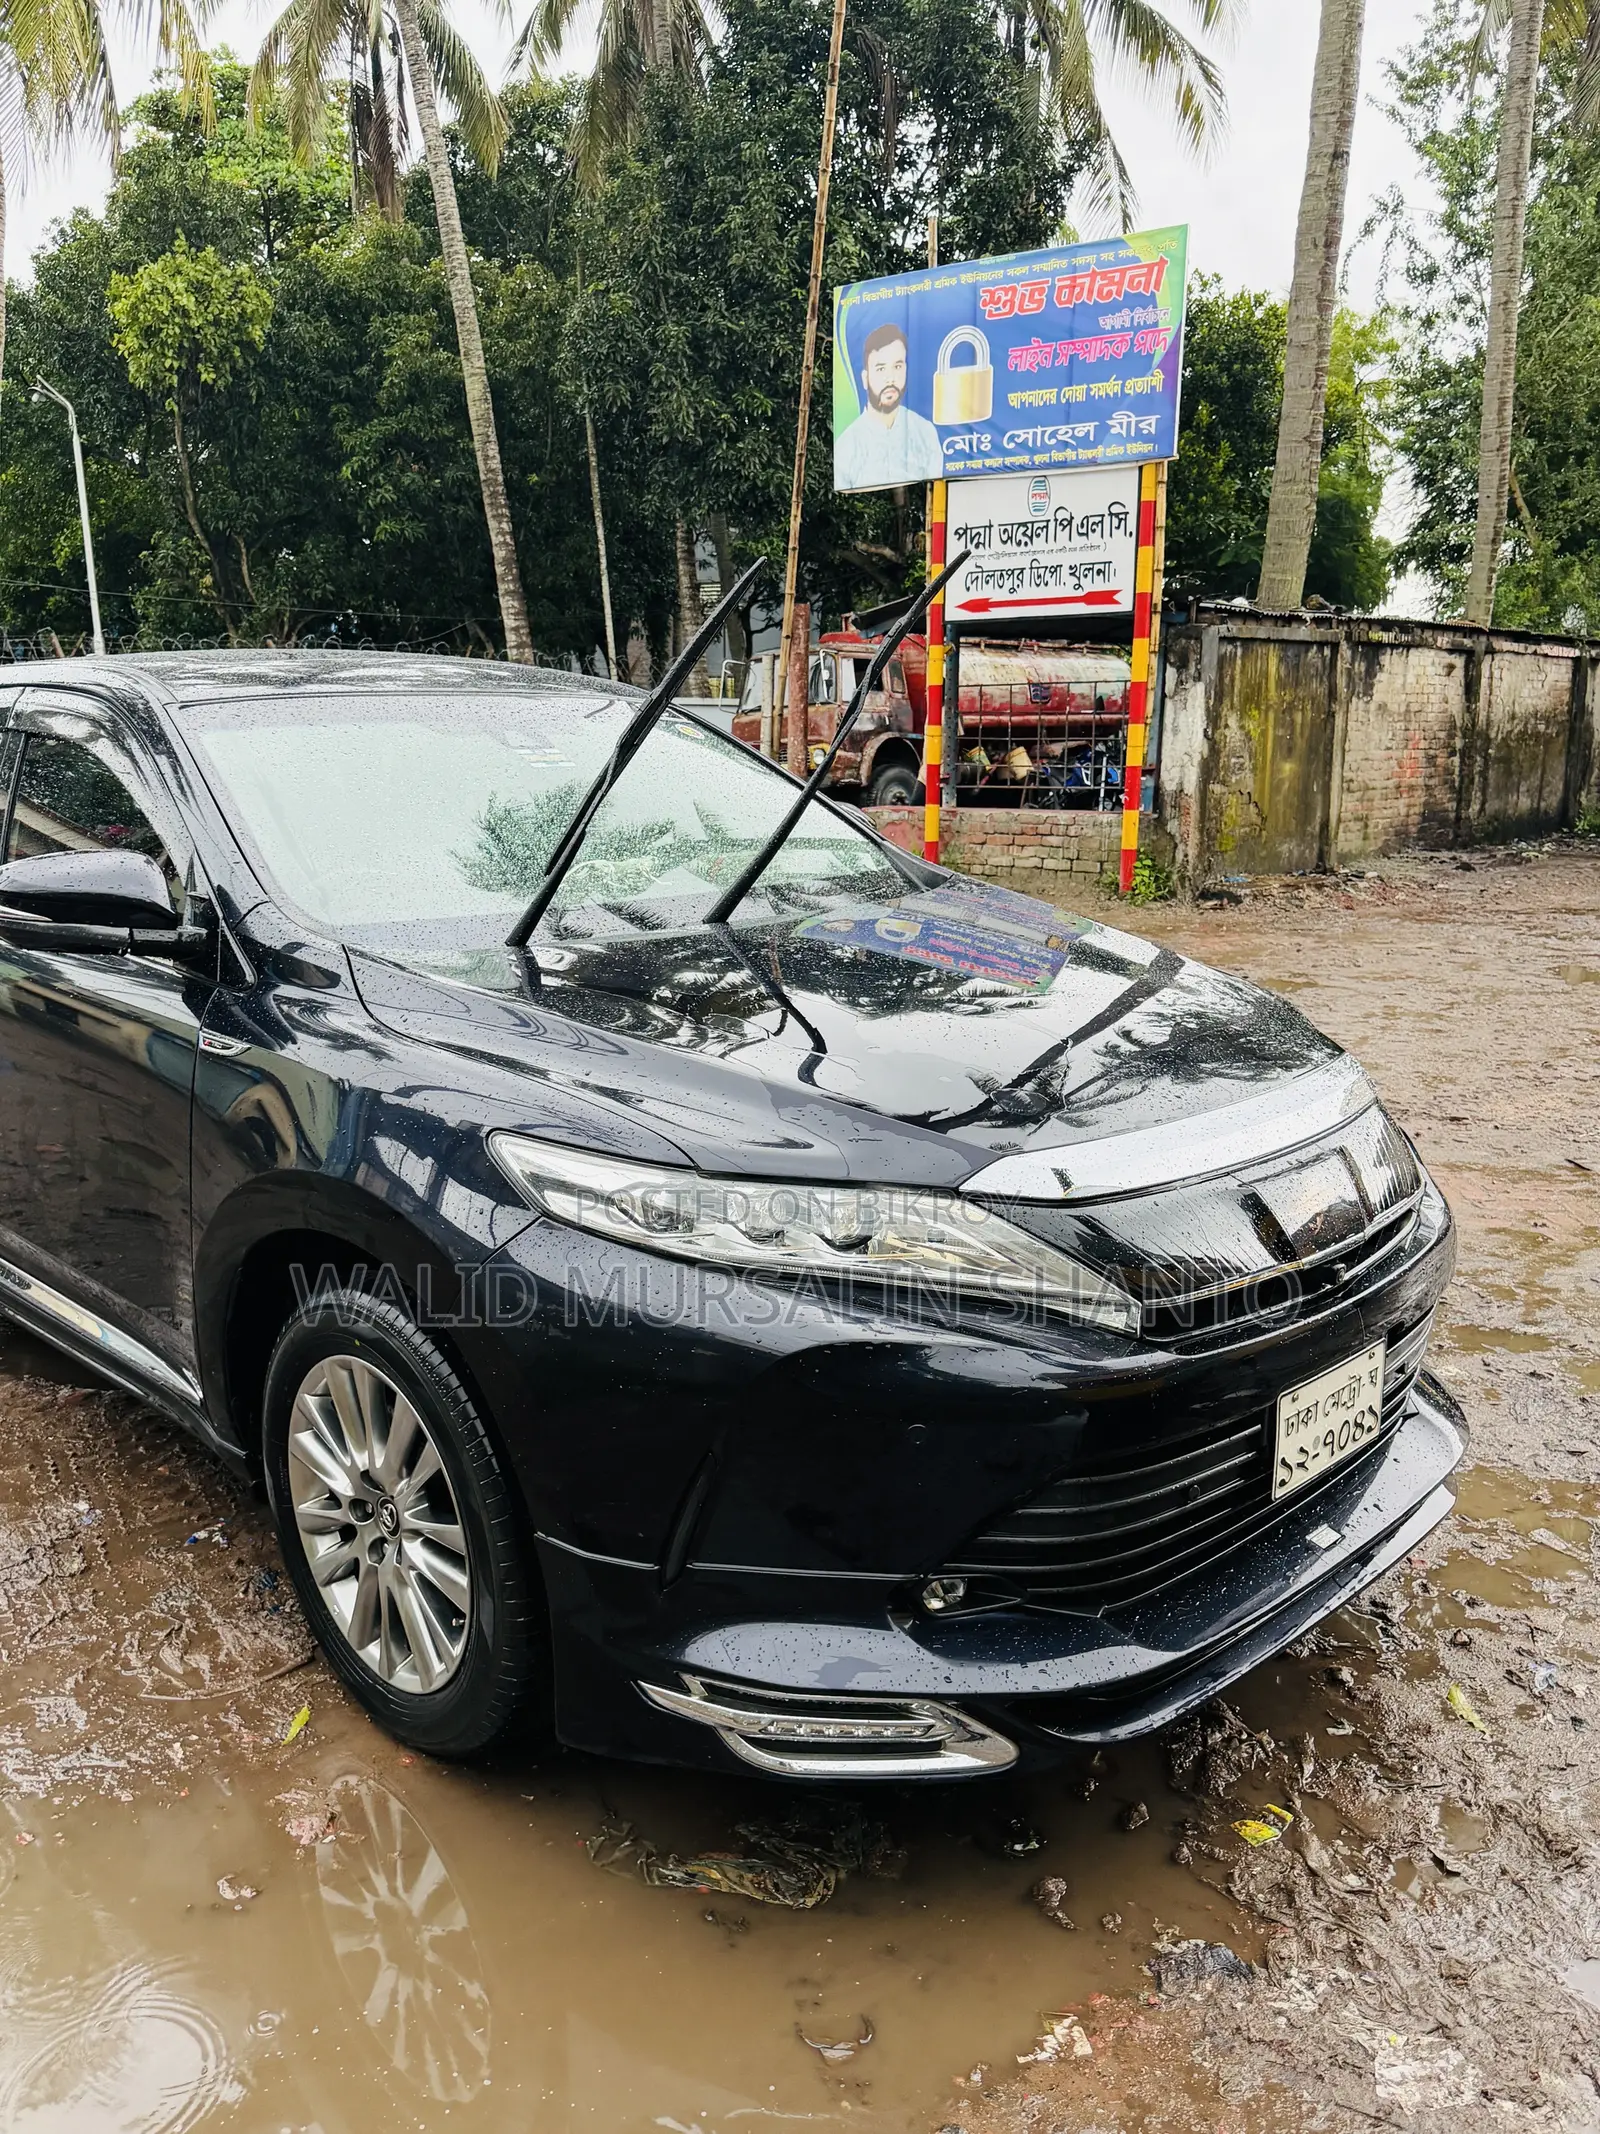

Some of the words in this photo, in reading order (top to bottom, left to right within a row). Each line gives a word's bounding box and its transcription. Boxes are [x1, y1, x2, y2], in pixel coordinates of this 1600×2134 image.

[862, 287, 893, 304] বিভাগীয়
[1006, 266, 1030, 277] সকল
[1032, 257, 1069, 272] সম্মানিত
[1099, 249, 1116, 263] সহ
[979, 279, 1051, 321] শুভ
[1054, 255, 1170, 309] কামনা
[1007, 337, 1055, 373] লাইন
[1055, 331, 1134, 367] সম্পাদক
[1134, 326, 1173, 356] পদে
[1007, 388, 1059, 410] আপনাদের
[1089, 374, 1123, 399] সমর্থন
[1124, 369, 1166, 395] প্রত্যাশী
[942, 432, 993, 455] মোঃ
[1002, 421, 1101, 449] সোহেল
[1105, 410, 1162, 439] মীর
[953, 518, 994, 551] পদ্মা
[998, 518, 1051, 548] অয়েল
[964, 562, 1026, 595] দৌলতপুর
[1284, 1400, 1320, 1438] ঢাকা
[1277, 1404, 1380, 1489] ১২-৭০৪১
